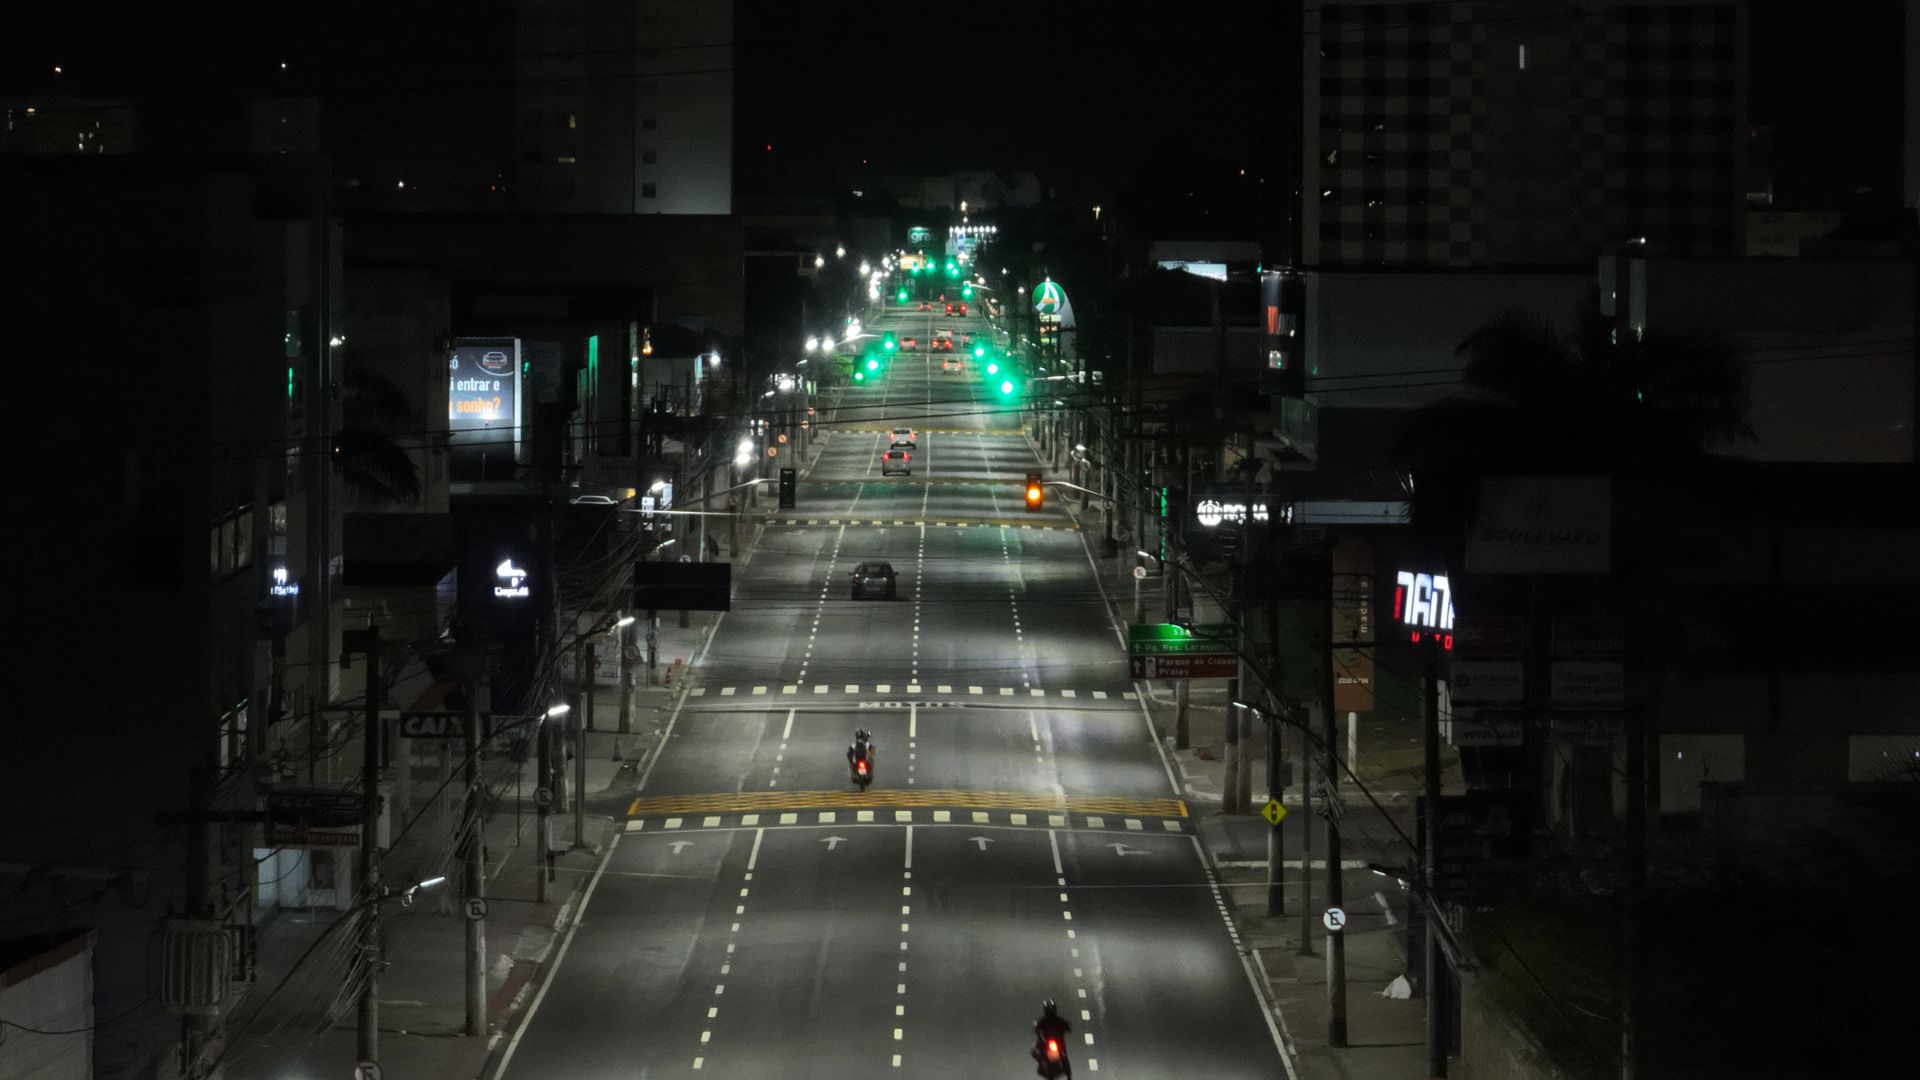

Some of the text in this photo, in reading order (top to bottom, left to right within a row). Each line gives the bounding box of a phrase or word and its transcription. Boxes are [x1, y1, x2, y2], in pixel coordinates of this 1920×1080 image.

[457, 377, 490, 391] entrar
[493, 380, 500, 391] e
[405, 716, 483, 735] CAIX
